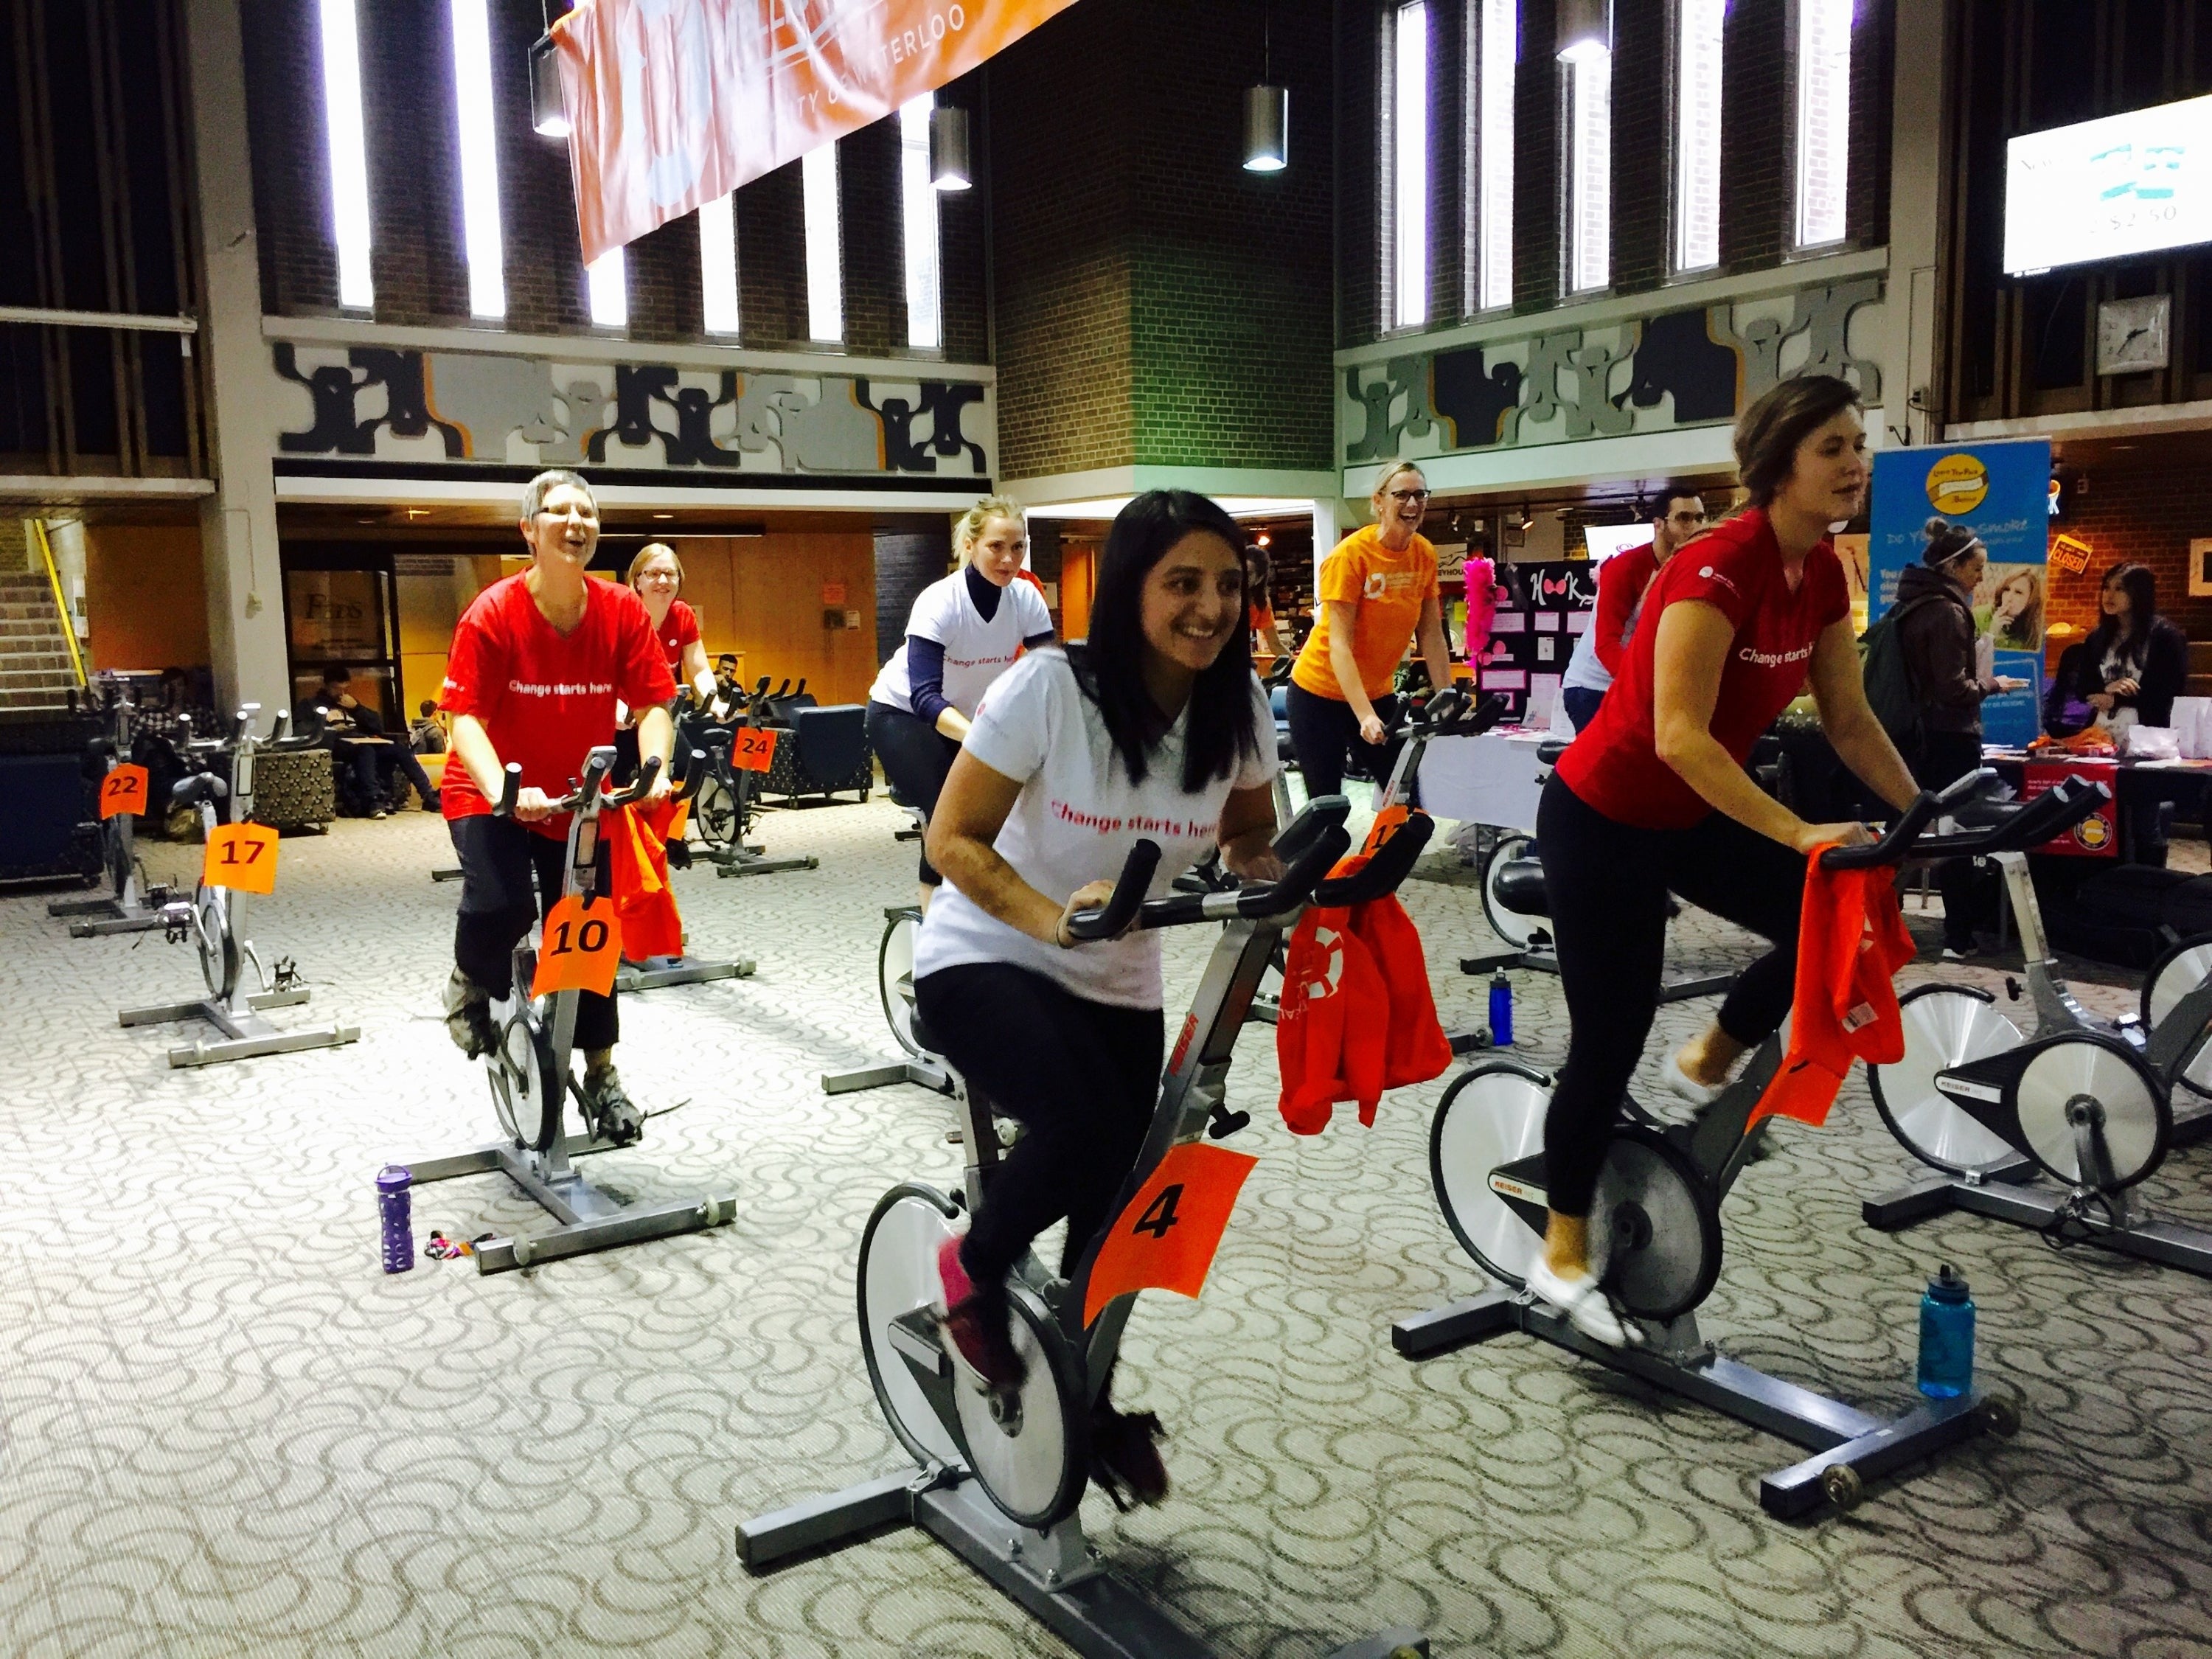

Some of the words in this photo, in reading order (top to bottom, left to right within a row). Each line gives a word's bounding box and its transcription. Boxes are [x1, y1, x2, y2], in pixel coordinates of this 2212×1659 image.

[2053, 549, 2084, 571] CLOSED
[978, 656, 1001, 664] starts
[1739, 647, 1783, 667] Change
[1784, 647, 1808, 662] starts
[509, 679, 552, 698] Change
[553, 682, 587, 695] starts
[589, 681, 613, 695] here
[742, 738, 768, 754] 24
[107, 776, 139, 796] 22
[1051, 799, 1121, 835] Change
[1127, 814, 1180, 836] starts
[220, 841, 265, 864] 17
[550, 919, 609, 956] 10
[1941, 1081, 1970, 1092] KEISER
[1495, 1181, 1523, 1195] KEISER
[1133, 1183, 1185, 1239] 4
